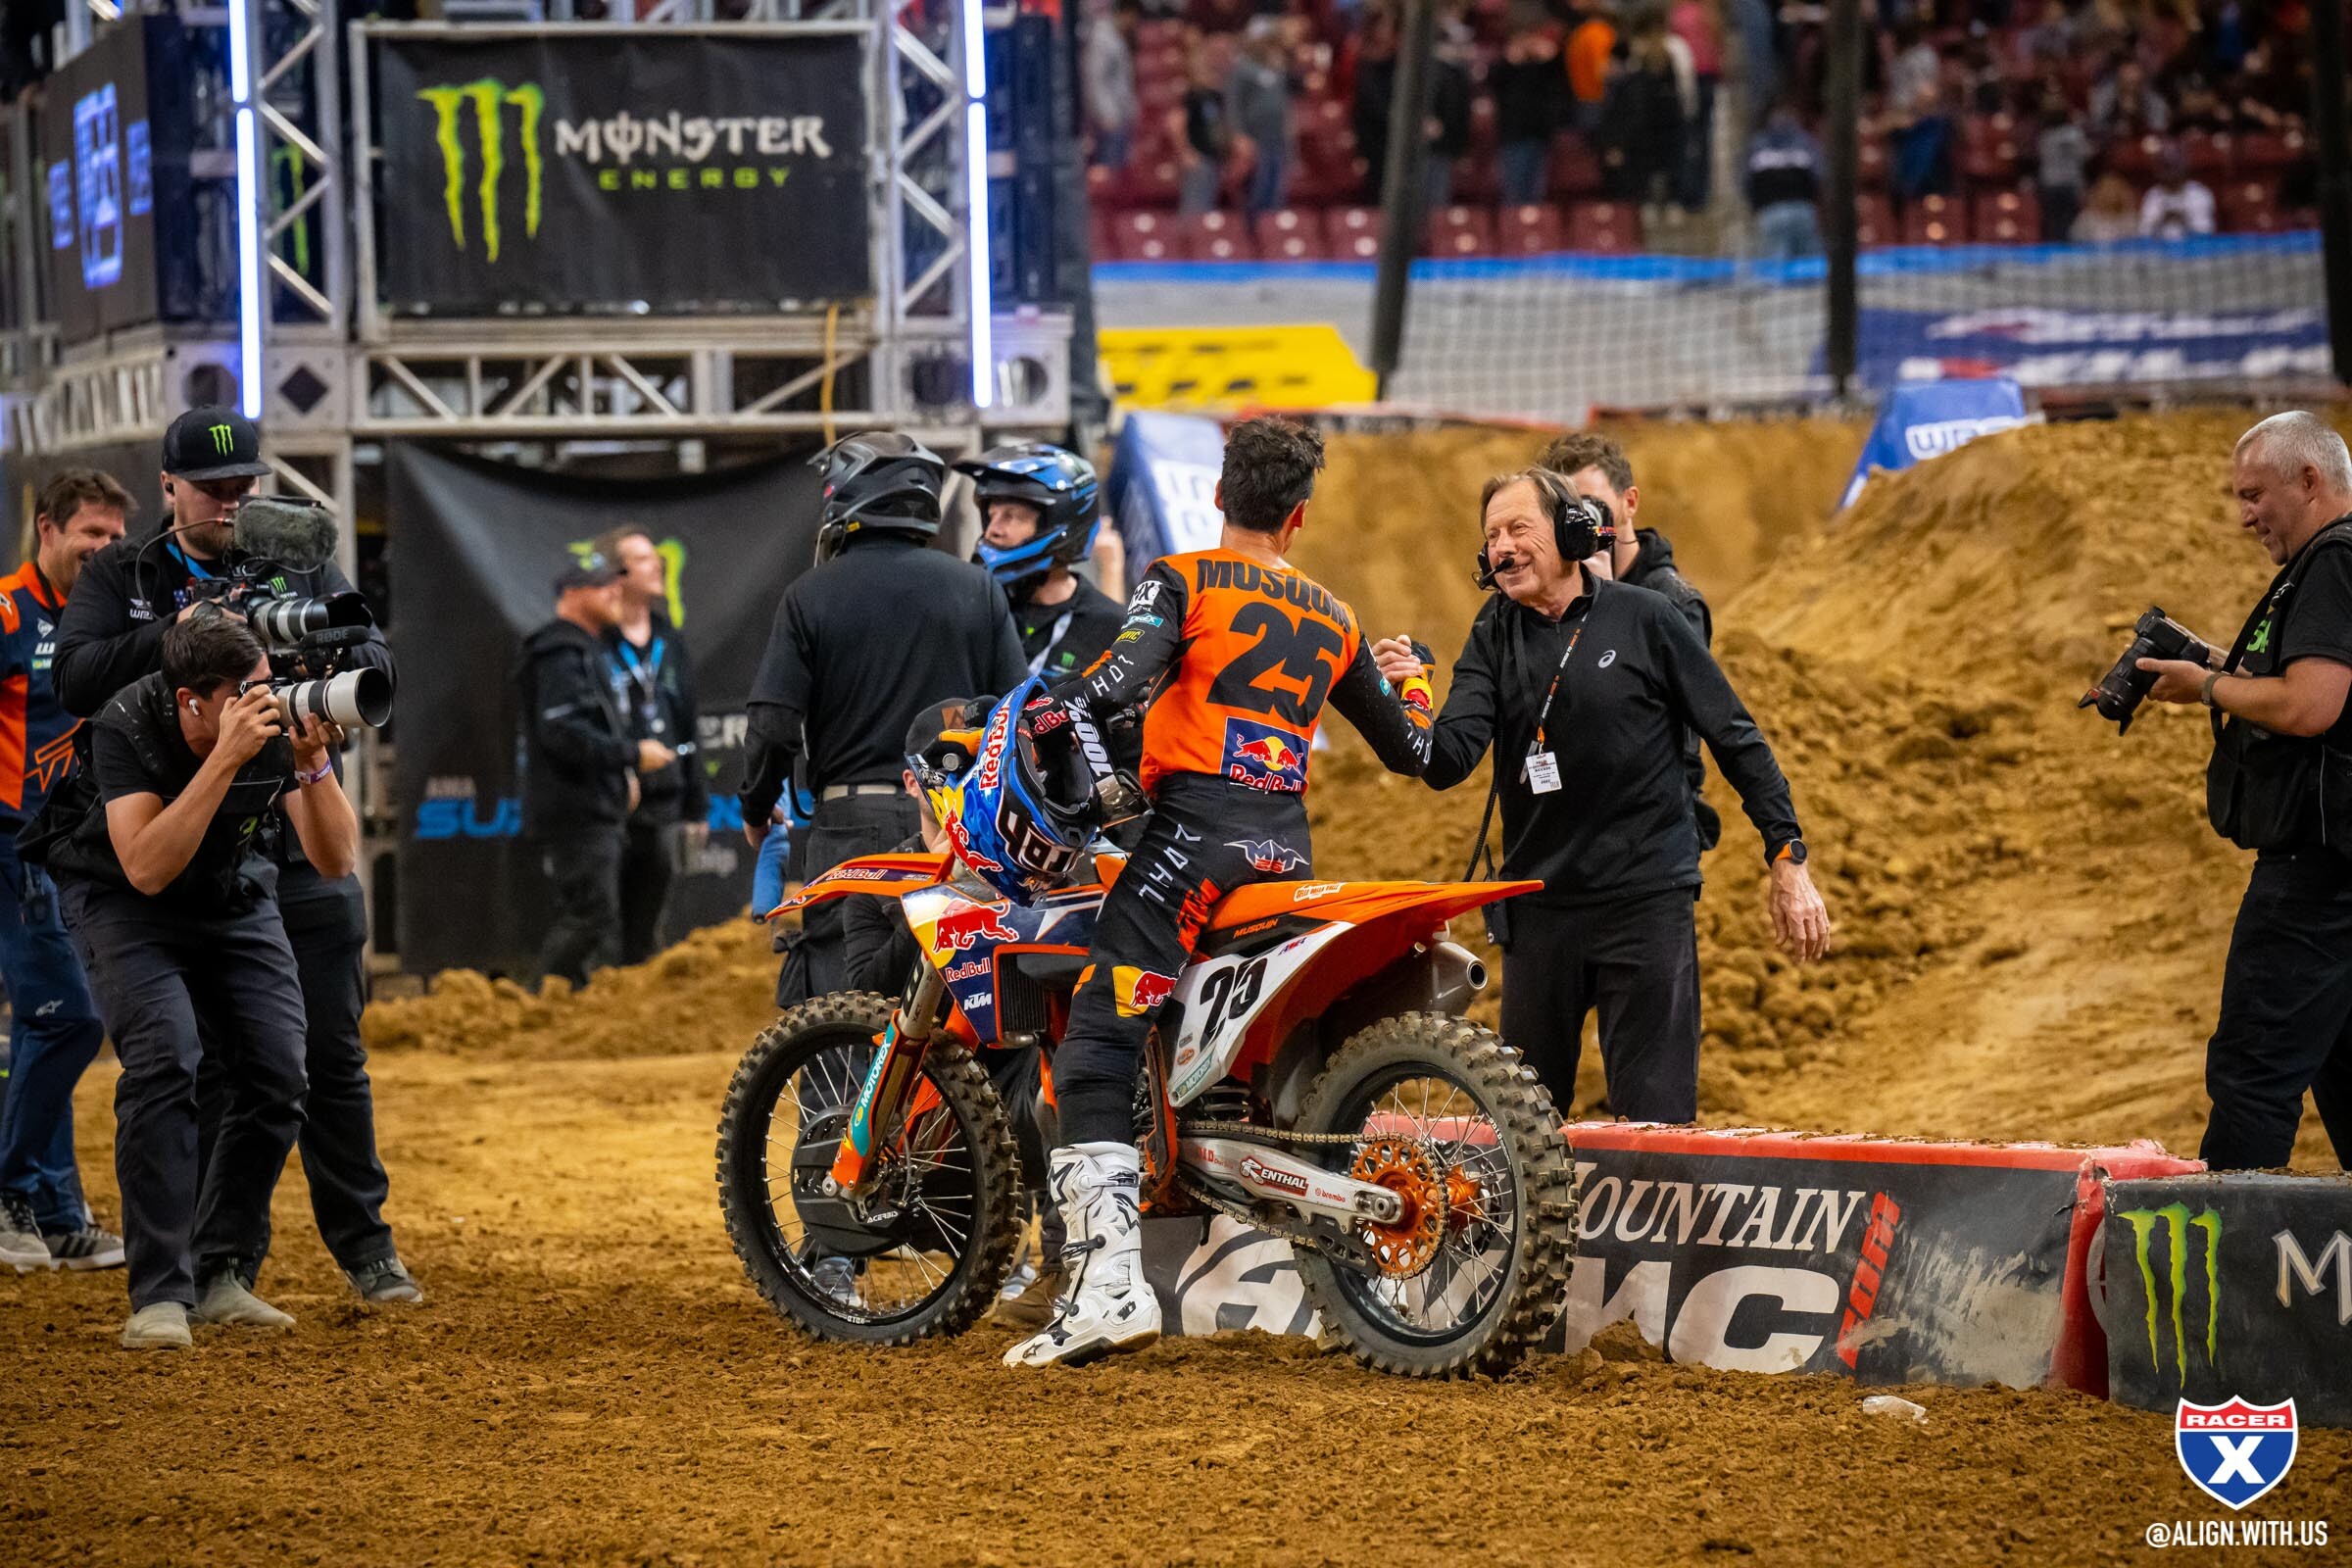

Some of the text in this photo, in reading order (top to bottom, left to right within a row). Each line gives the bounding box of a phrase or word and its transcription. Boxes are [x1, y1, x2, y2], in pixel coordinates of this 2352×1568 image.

[554, 110, 832, 165] MONSTER
[599, 168, 791, 190] ENERGY
[1197, 558, 1352, 635] MUSQUIN
[1205, 601, 1345, 728] 25
[1233, 917, 1279, 940] MUSQUIN
[946, 957, 992, 983] Red Bull
[963, 992, 993, 1011] KTM
[860, 1039, 891, 1107] MOTOREX
[1321, 1190, 1347, 1203] brembo
